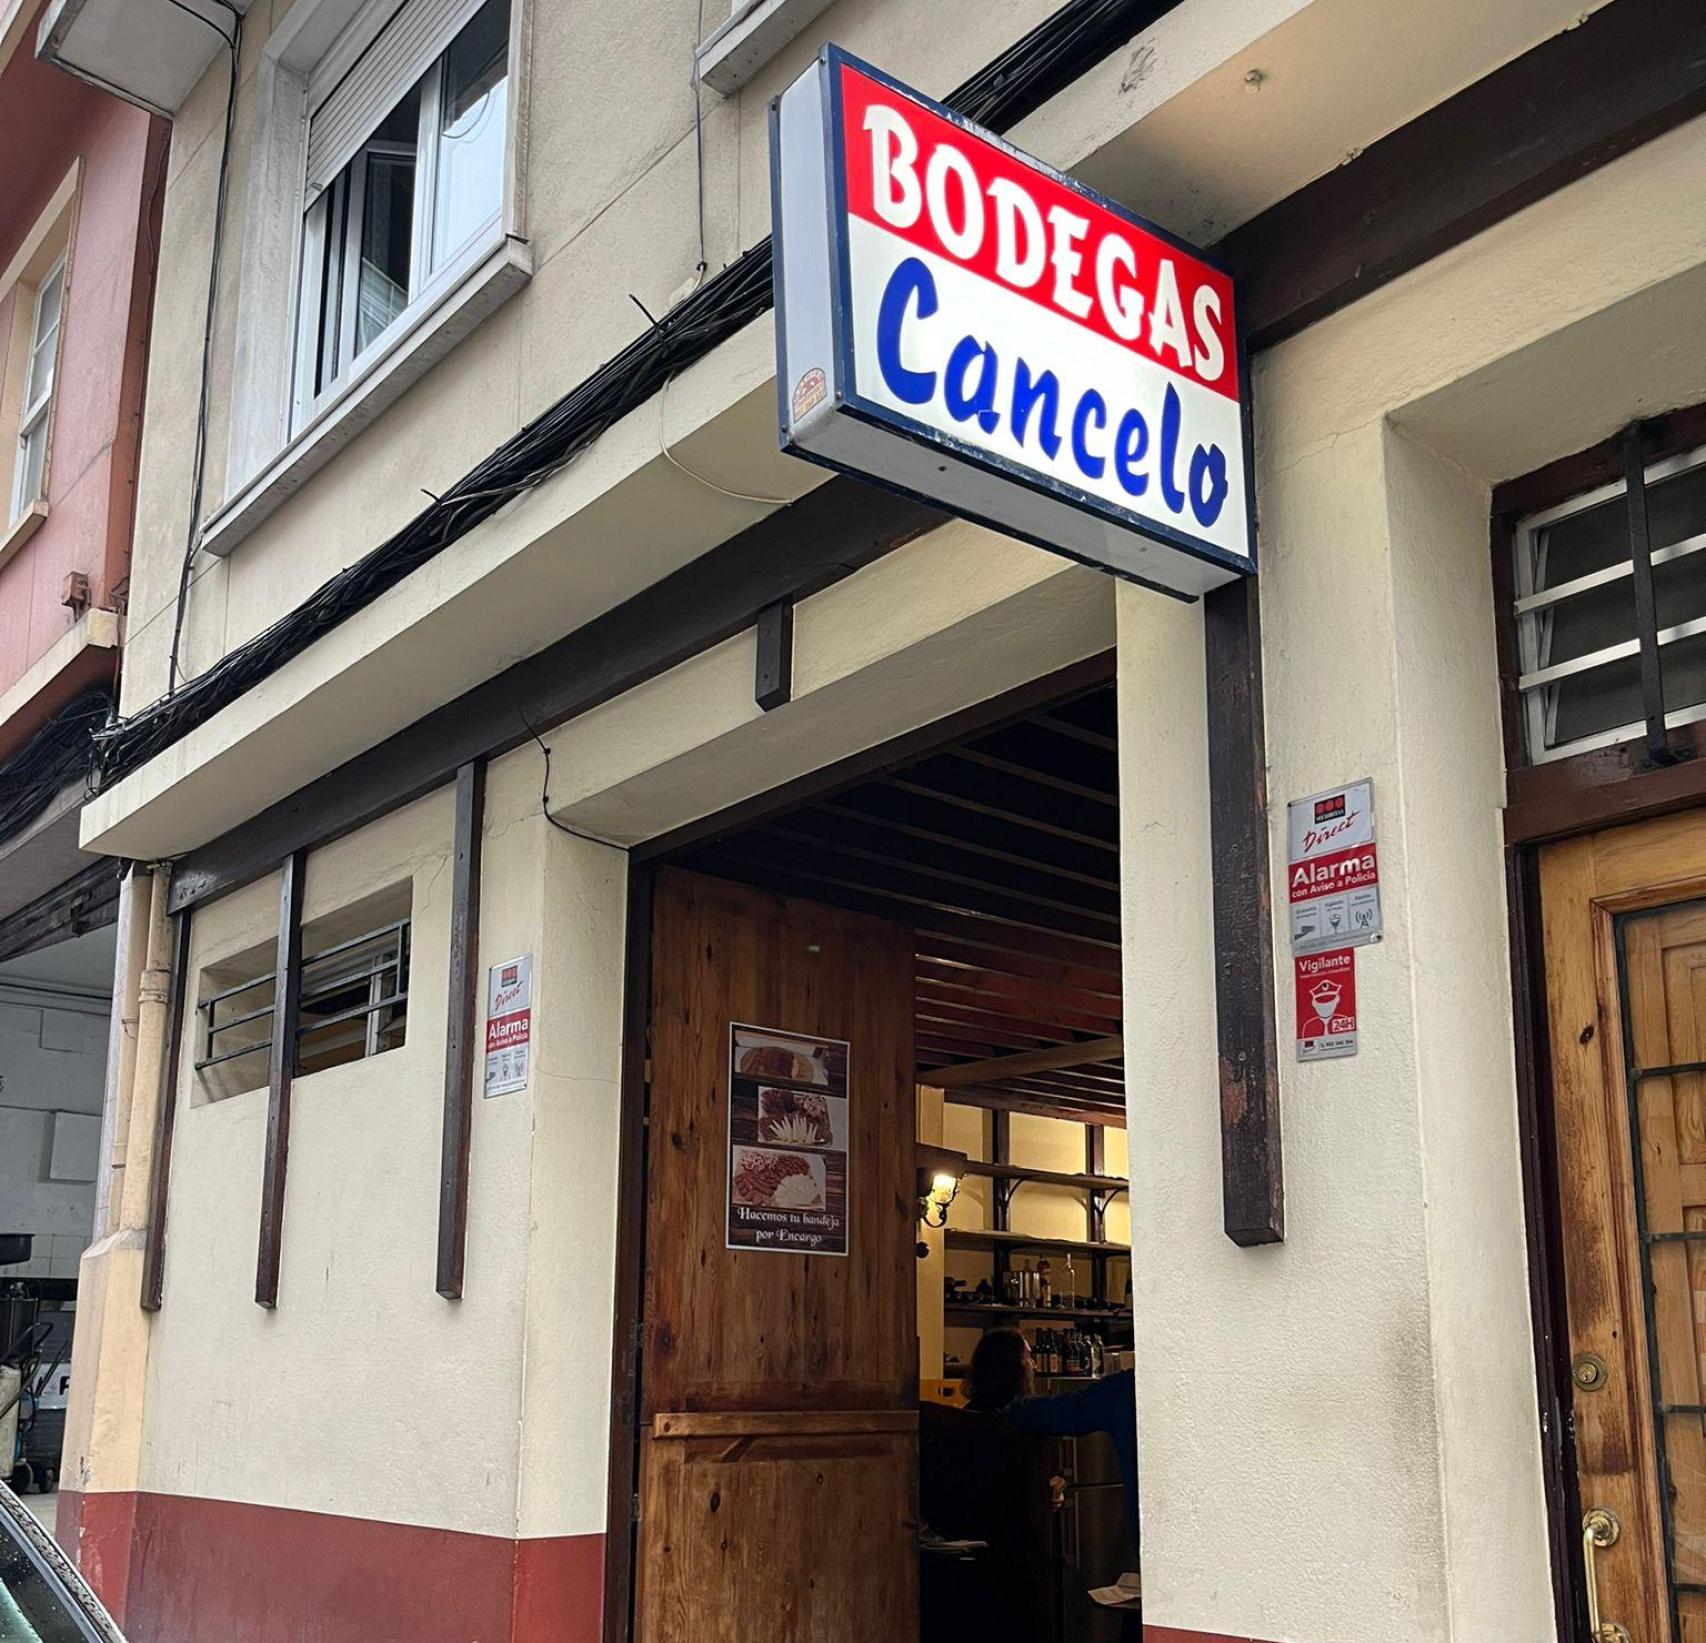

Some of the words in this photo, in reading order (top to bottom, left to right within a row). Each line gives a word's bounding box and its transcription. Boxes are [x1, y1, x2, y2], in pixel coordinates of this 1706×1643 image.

[864, 104, 1223, 381] BODEGAS
[876, 256, 1228, 528] Cancelo
[1303, 809, 1361, 853] Direct
[1292, 854, 1375, 888] Alarma
[1292, 889, 1308, 898] con
[1310, 882, 1335, 894] Aviso
[1299, 955, 1351, 973] Vigilante
[488, 1018, 529, 1041] Alarma
[1333, 1018, 1354, 1031] 24H
[737, 1207, 788, 1221] Hacemos
[790, 1213, 801, 1223] tu
[802, 1212, 840, 1231] bandeja
[756, 1229, 774, 1243] por
[776, 1228, 823, 1247] Encargo
